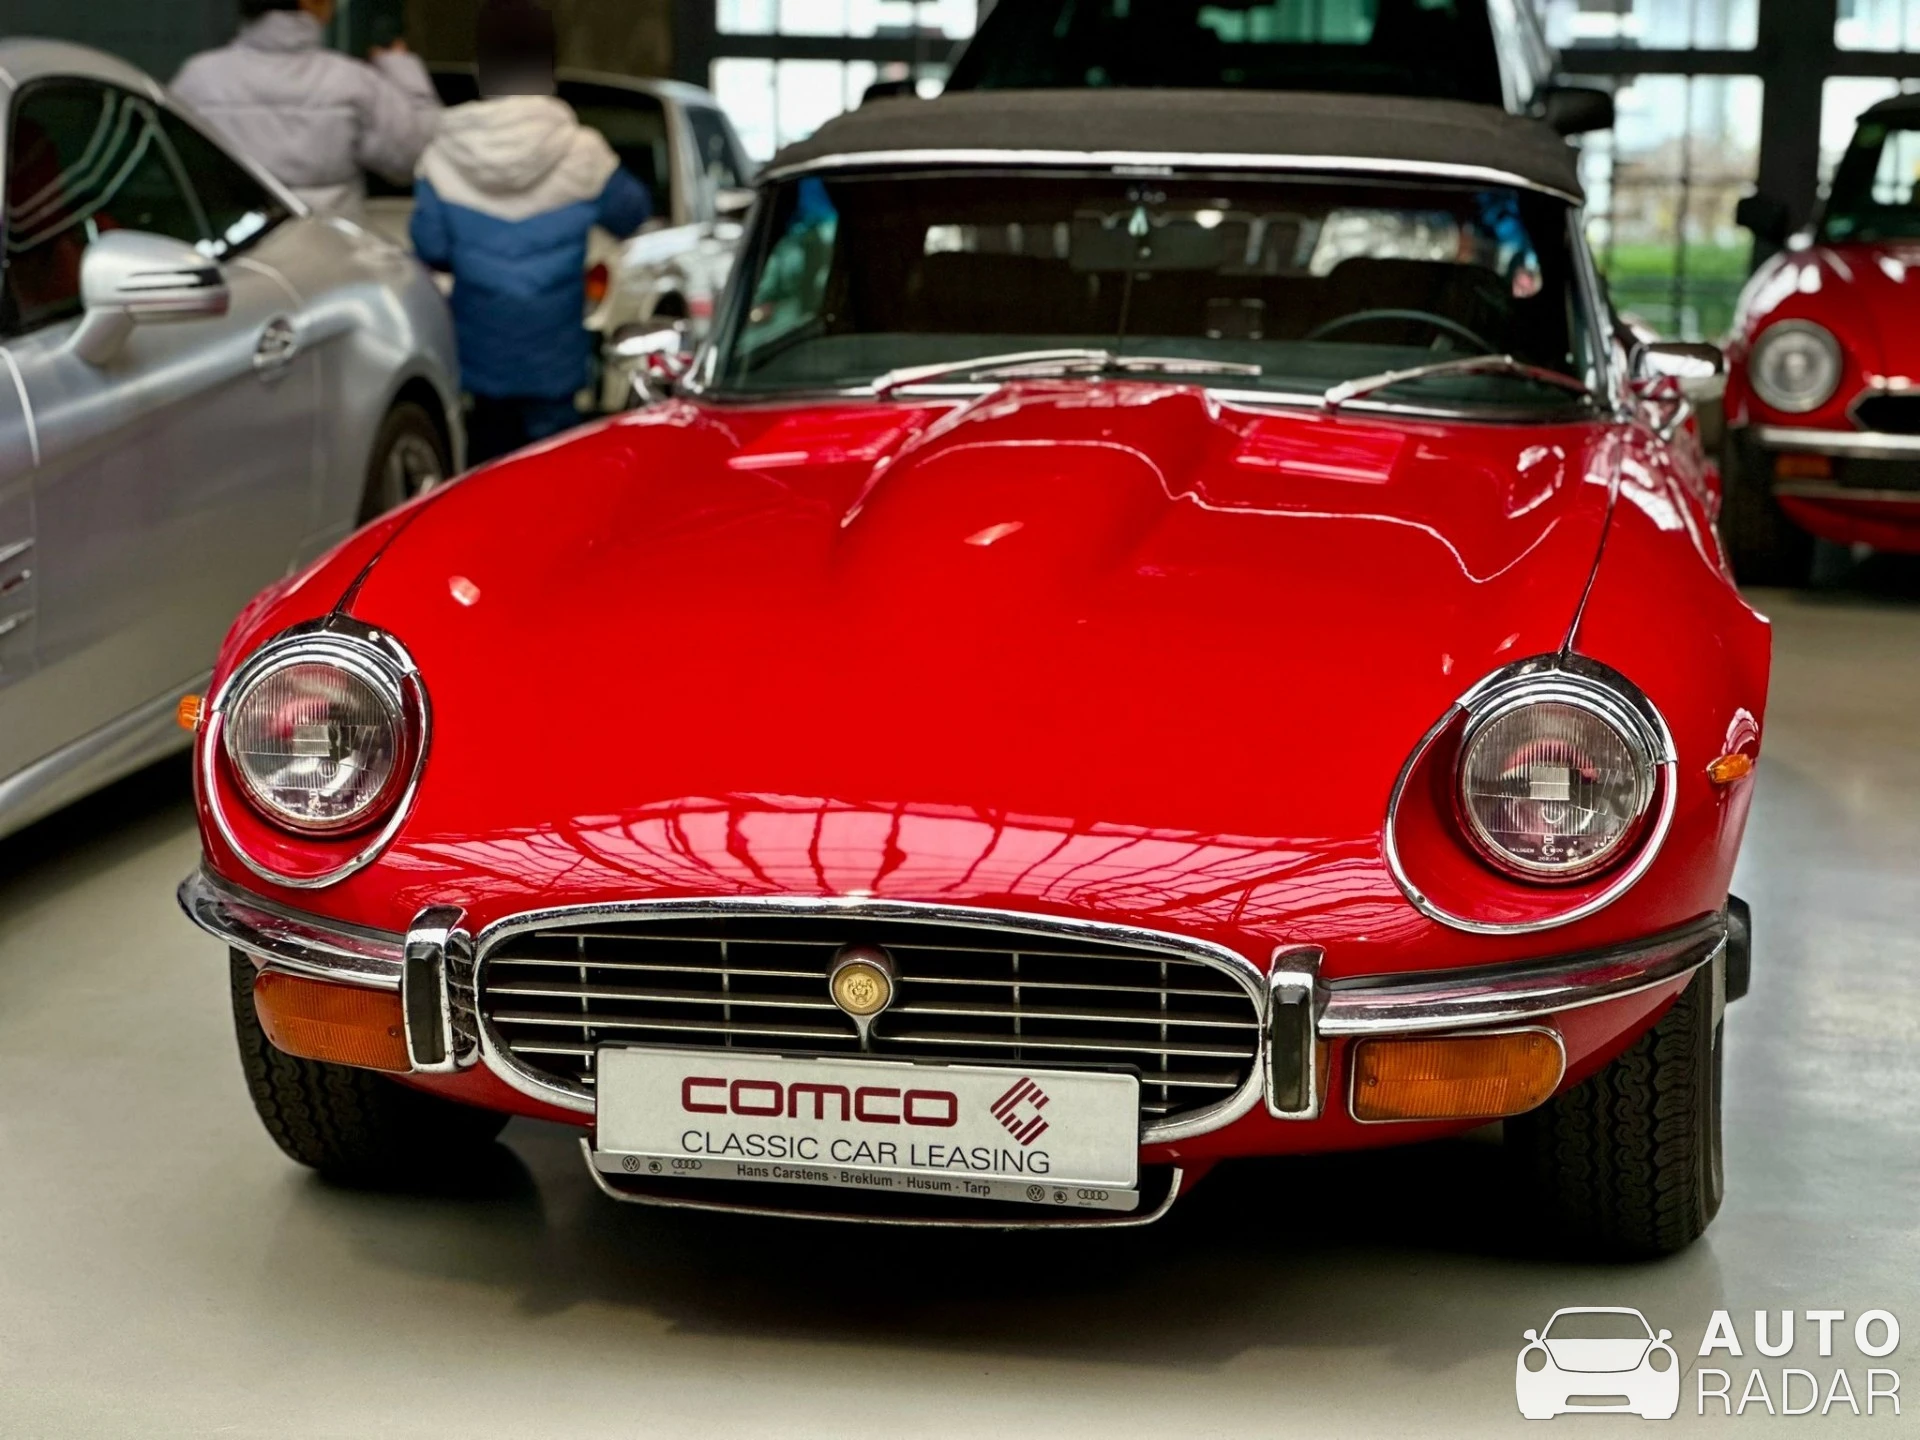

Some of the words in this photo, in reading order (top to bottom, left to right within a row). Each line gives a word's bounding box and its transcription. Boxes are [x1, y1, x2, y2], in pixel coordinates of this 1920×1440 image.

[682, 1130, 818, 1160] CLASSIC
[831, 1139, 897, 1165] CAR
[911, 1143, 1050, 1174] LEASING
[737, 1164, 769, 1178] Hans
[773, 1166, 829, 1182] Carstens
[841, 1171, 893, 1187] Breklum
[907, 1176, 952, 1192] Husum
[963, 1181, 991, 1196] Tarp
